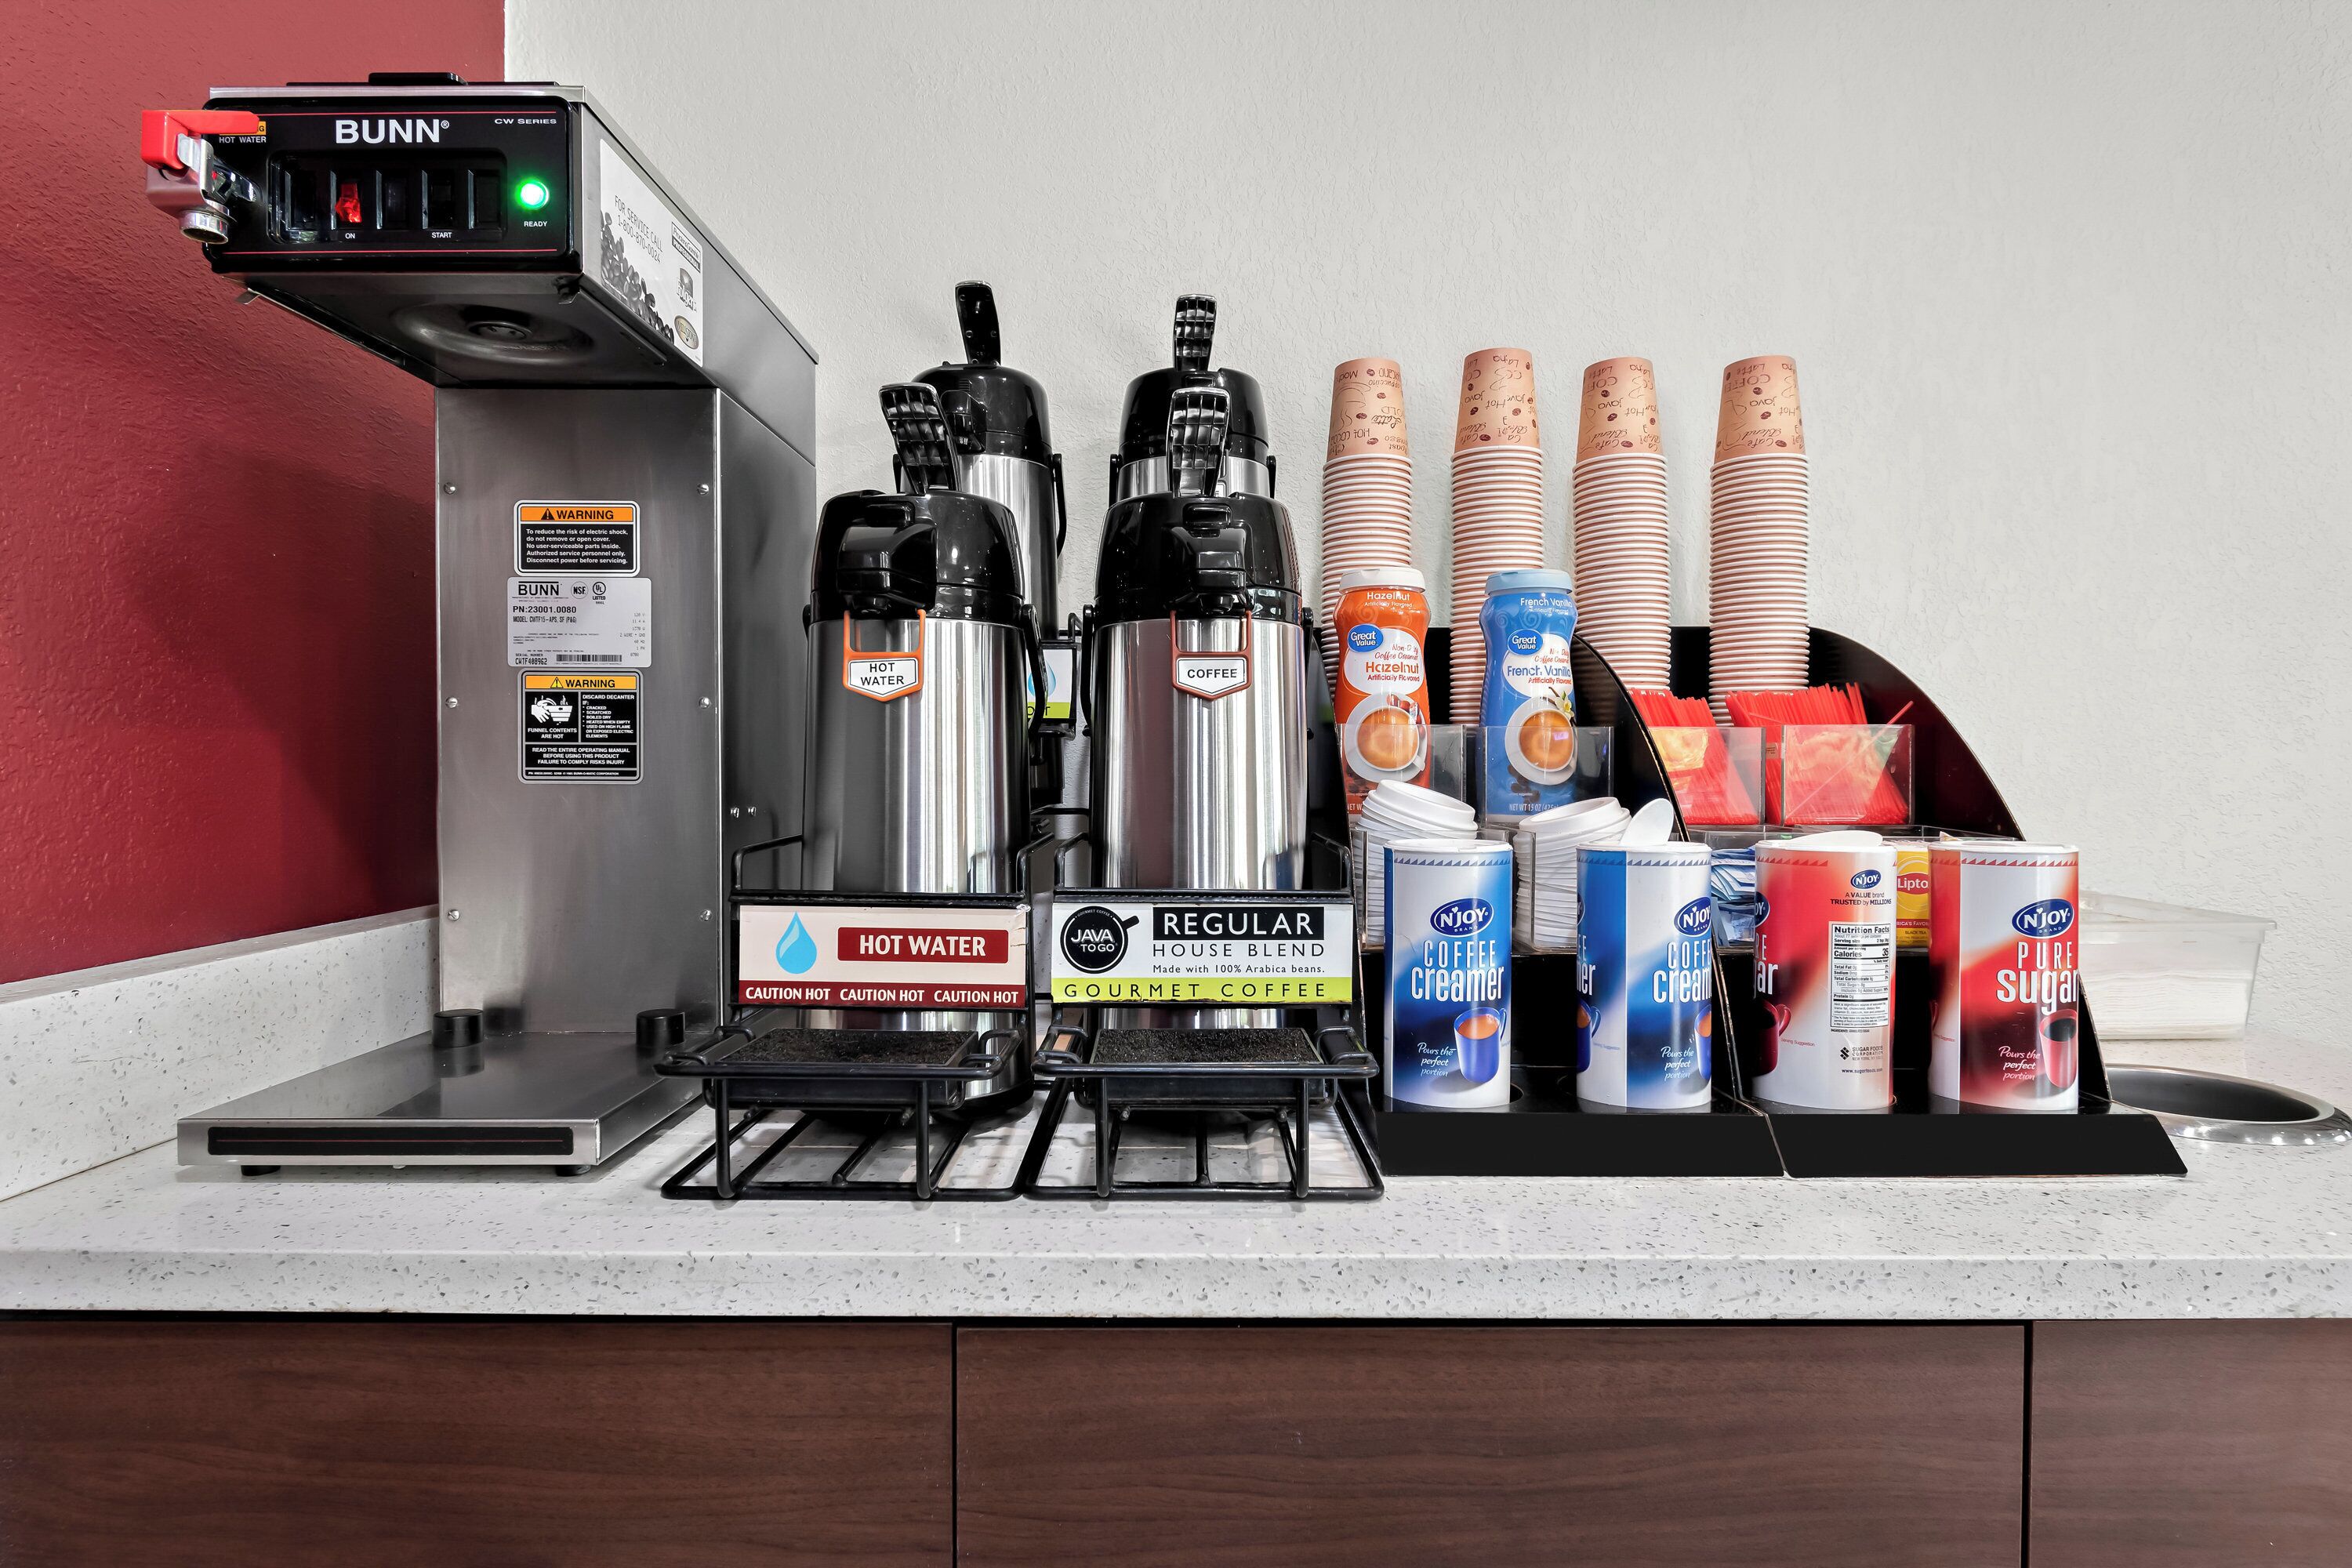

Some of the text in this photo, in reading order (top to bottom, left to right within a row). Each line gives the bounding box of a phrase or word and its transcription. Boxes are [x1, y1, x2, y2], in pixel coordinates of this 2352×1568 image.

[220, 135, 235, 143] HOT
[615, 195, 662, 253] FOR SERVICE CALL
[618, 215, 661, 263] 1-800-870-0024
[556, 510, 614, 520] WARNING
[518, 584, 560, 596] BUNN
[1367, 591, 1410, 601] Hazelnut
[1351, 631, 1377, 641] Great
[1512, 636, 1537, 644] Great
[869, 662, 895, 673] HOT
[1188, 669, 1238, 678] COFFEE
[1366, 662, 1419, 674] Hazelnut
[861, 676, 904, 686] WATER
[1897, 877, 1929, 891] Lipto
[1164, 913, 1313, 935] REGULAR
[1070, 929, 1115, 942] JAVA
[860, 935, 985, 956] HOT WATER
[1080, 943, 1115, 953] TO GO
[1153, 943, 1323, 956] HOUSE BLEND
[1424, 940, 1496, 969] COFFEE
[2017, 941, 2072, 970] PURE
[1185, 964, 1208, 973] with
[1216, 964, 1241, 973] 100%
[1246, 964, 1286, 973] Arabica
[1291, 964, 1324, 973] beans.
[1065, 983, 1325, 997] GOURMET COFFEE
[1411, 967, 1504, 1003] creamer
[746, 987, 1018, 1003] CAUTION HOT CAUTION HOT CAUTION HOT
[1996, 968, 2078, 1016] sugar
[1417, 1042, 1454, 1056] Pours the
[1661, 1046, 1693, 1058] Pours the
[1998, 1046, 2040, 1060] Pours the
[1421, 1056, 1449, 1067] perfect
[1664, 1058, 1690, 1071] perfect
[2003, 1060, 2036, 1071] perfect
[1421, 1068, 1448, 1077] portion
[1664, 1070, 1690, 1081] portion
[2003, 1072, 2035, 1081] portion
